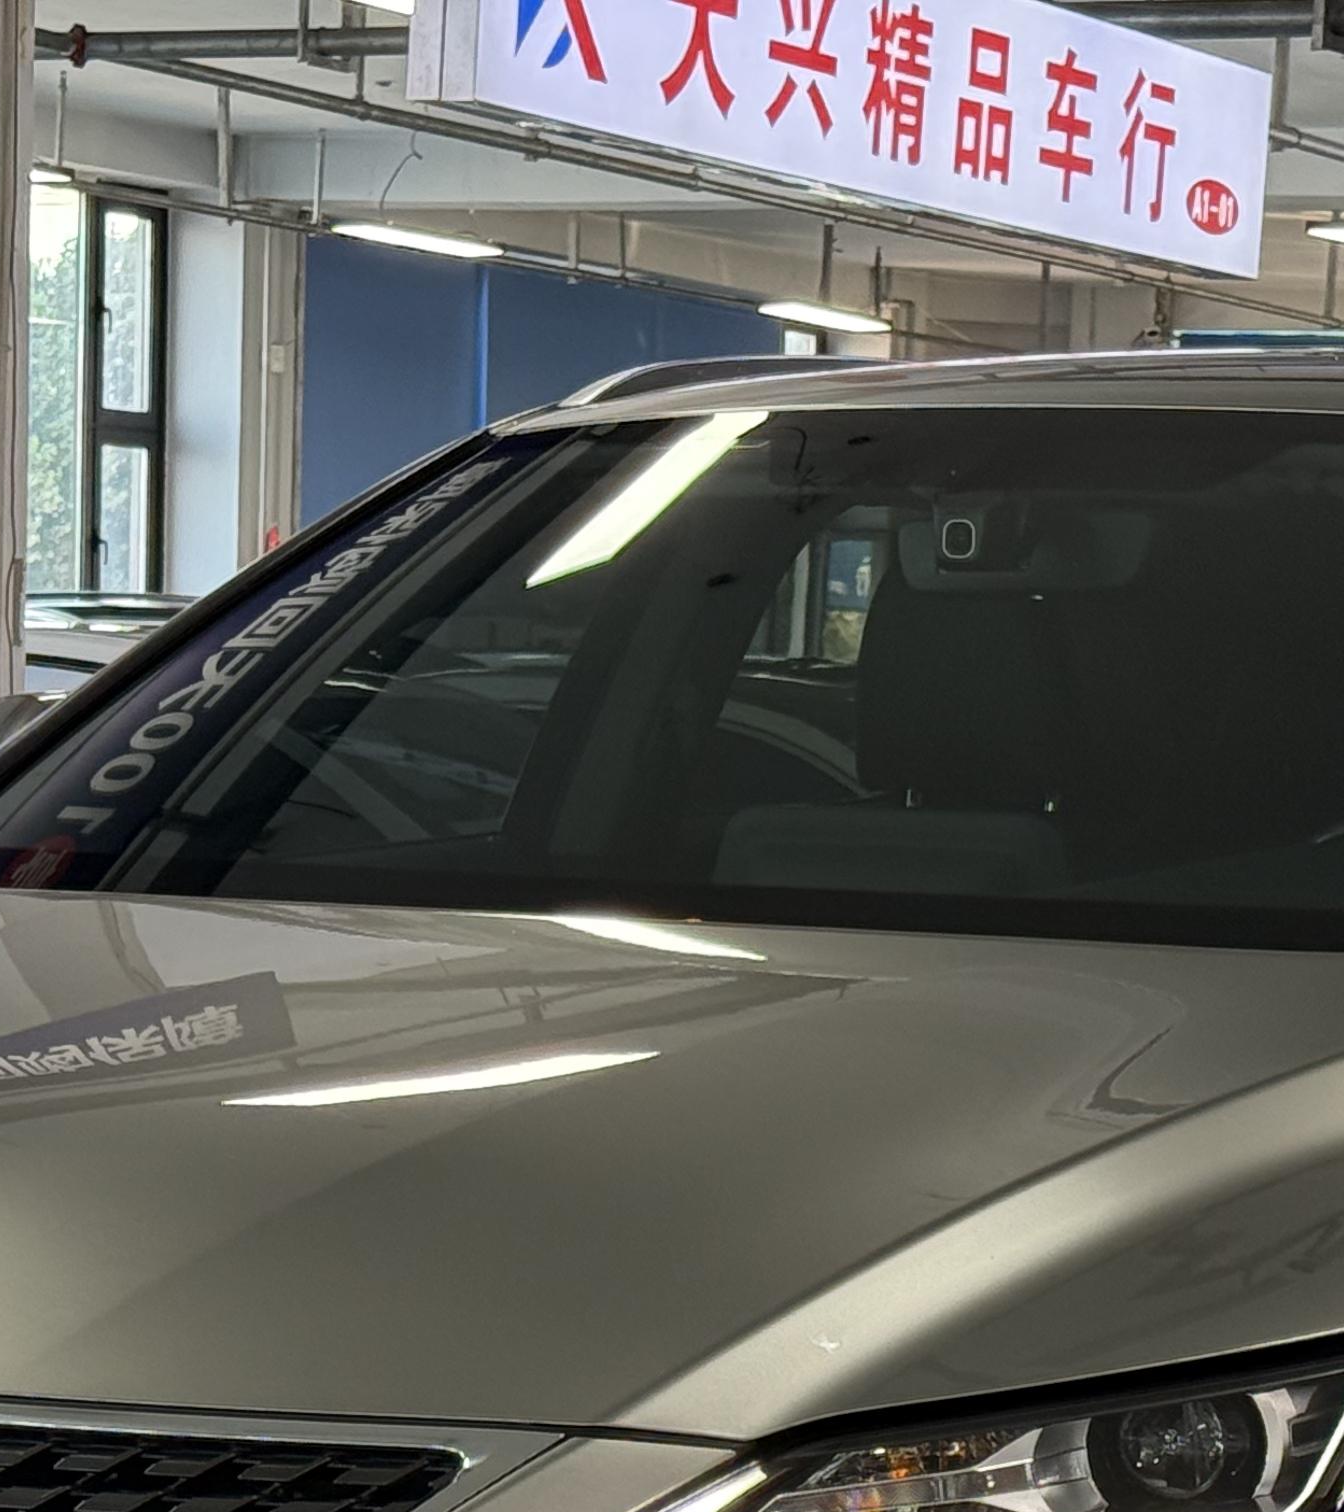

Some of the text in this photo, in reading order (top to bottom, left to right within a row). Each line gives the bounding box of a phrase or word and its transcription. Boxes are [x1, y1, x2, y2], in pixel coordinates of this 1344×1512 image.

[659, 0, 1178, 223] 大兴精品车行
